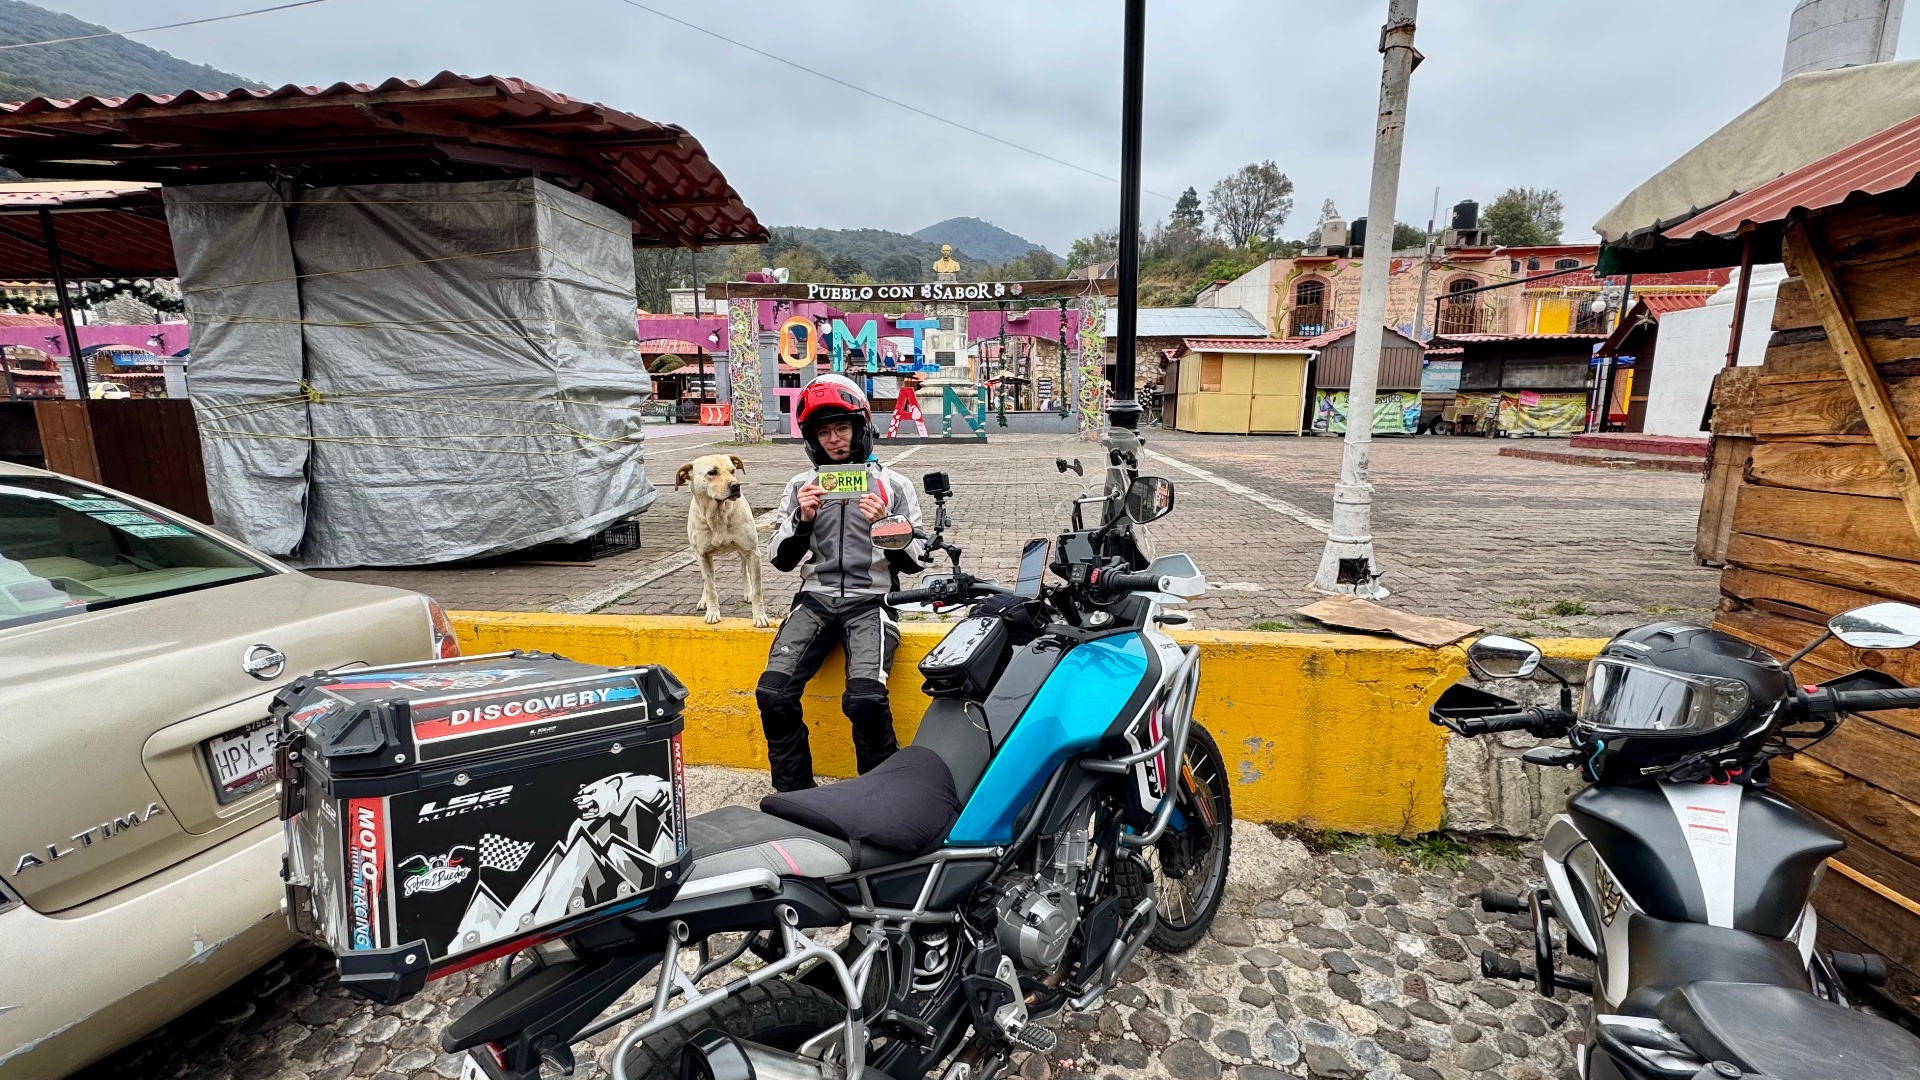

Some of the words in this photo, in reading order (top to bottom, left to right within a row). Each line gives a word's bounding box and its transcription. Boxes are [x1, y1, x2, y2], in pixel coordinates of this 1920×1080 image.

[779, 315, 941, 373] OMI
[772, 385, 987, 439] TAN
[838, 476, 863, 487] RRM
[450, 687, 611, 727] DISCOVERY
[321, 798, 337, 822] LS2
[417, 798, 511, 824] ALUCASE
[418, 785, 514, 816] LS2
[12, 802, 166, 877] ALTIMA
[358, 806, 379, 883] MOTO
[354, 886, 369, 947] RACING
